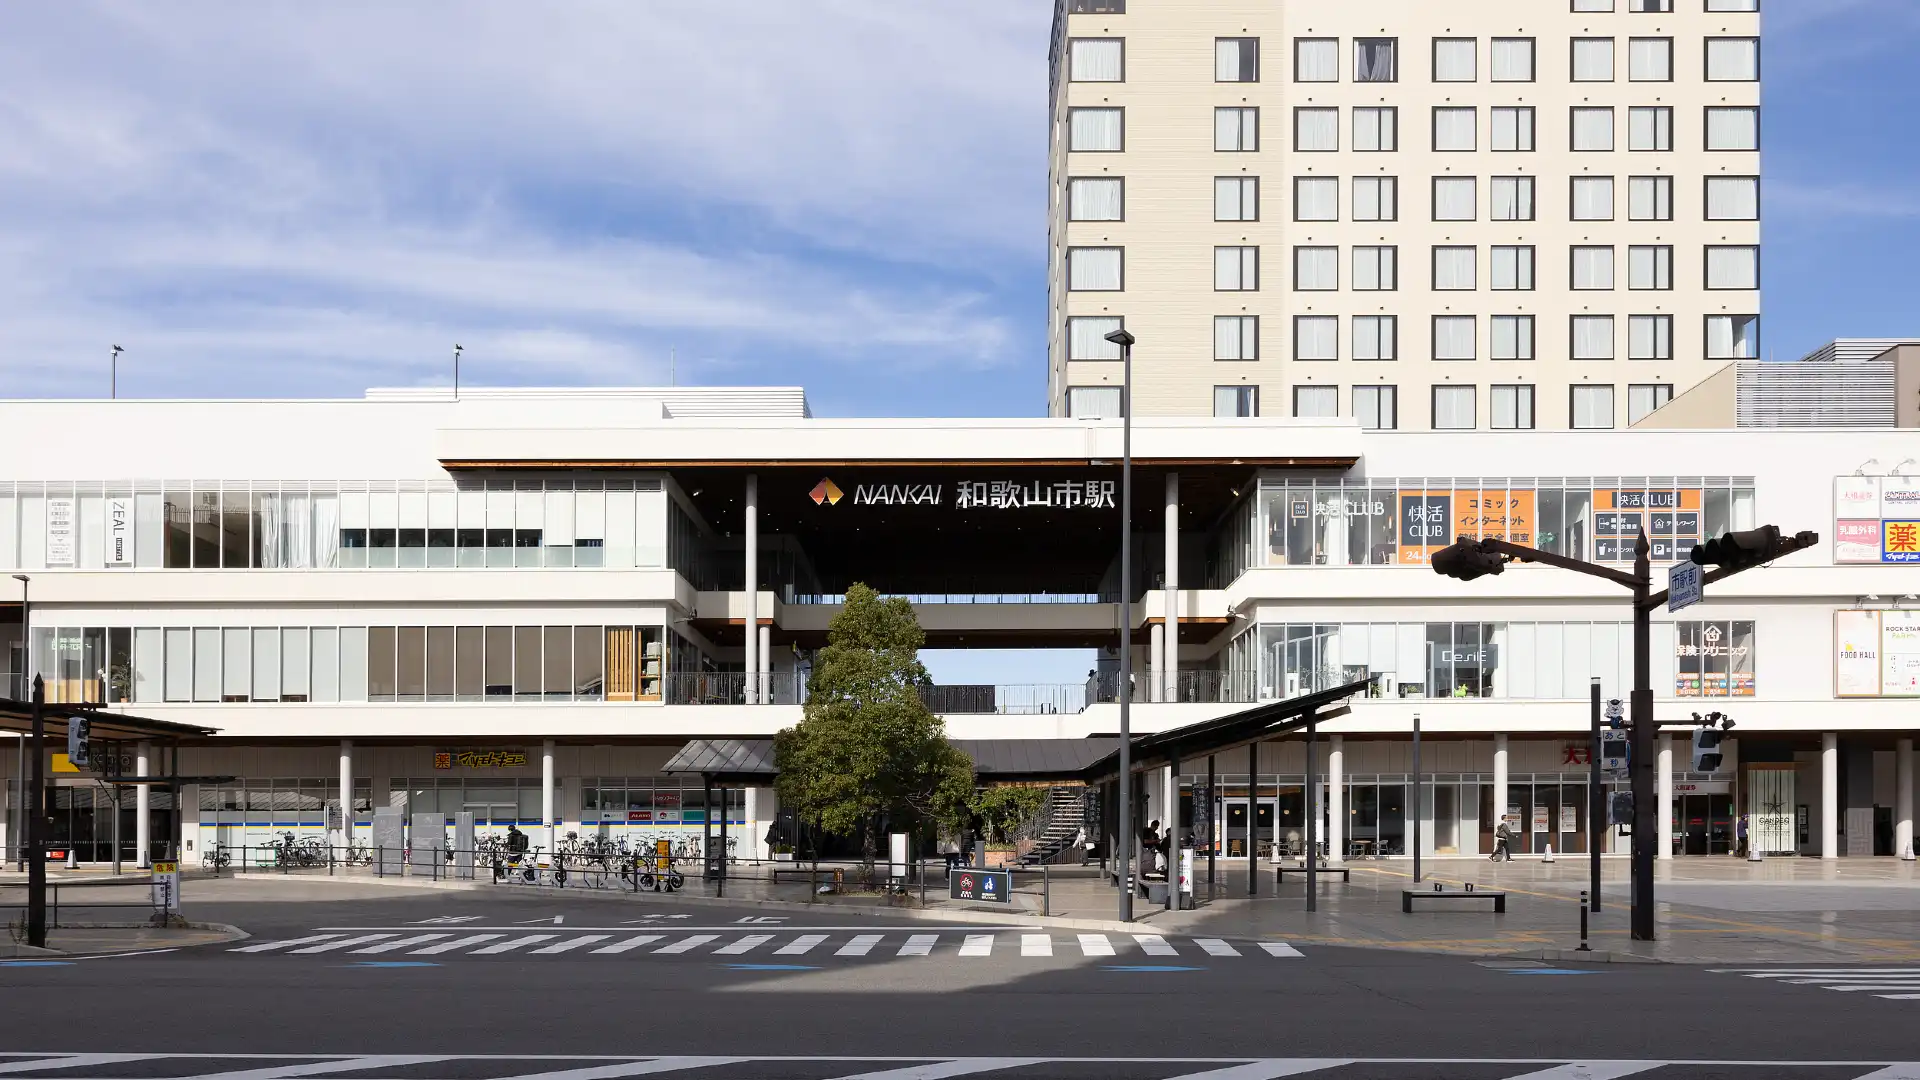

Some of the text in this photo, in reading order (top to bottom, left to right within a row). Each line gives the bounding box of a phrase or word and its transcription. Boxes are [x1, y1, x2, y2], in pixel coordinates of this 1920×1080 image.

[854, 480, 1116, 509] NANKAI 和歌山市駅
[1469, 499, 1519, 509] コミック
[112, 501, 125, 536] ZEAL
[1408, 505, 1444, 523] 快活
[1460, 516, 1525, 526] インターネット
[1409, 525, 1444, 537] CLUB
[1889, 523, 1917, 552] 薬
[1671, 566, 1697, 592] 市駅前
[1676, 645, 1748, 657] 保険クリニック
[1840, 651, 1876, 659] FOOD HALL
[1604, 731, 1625, 740] あと
[436, 753, 450, 769] 薬
[156, 863, 175, 873] 危険
